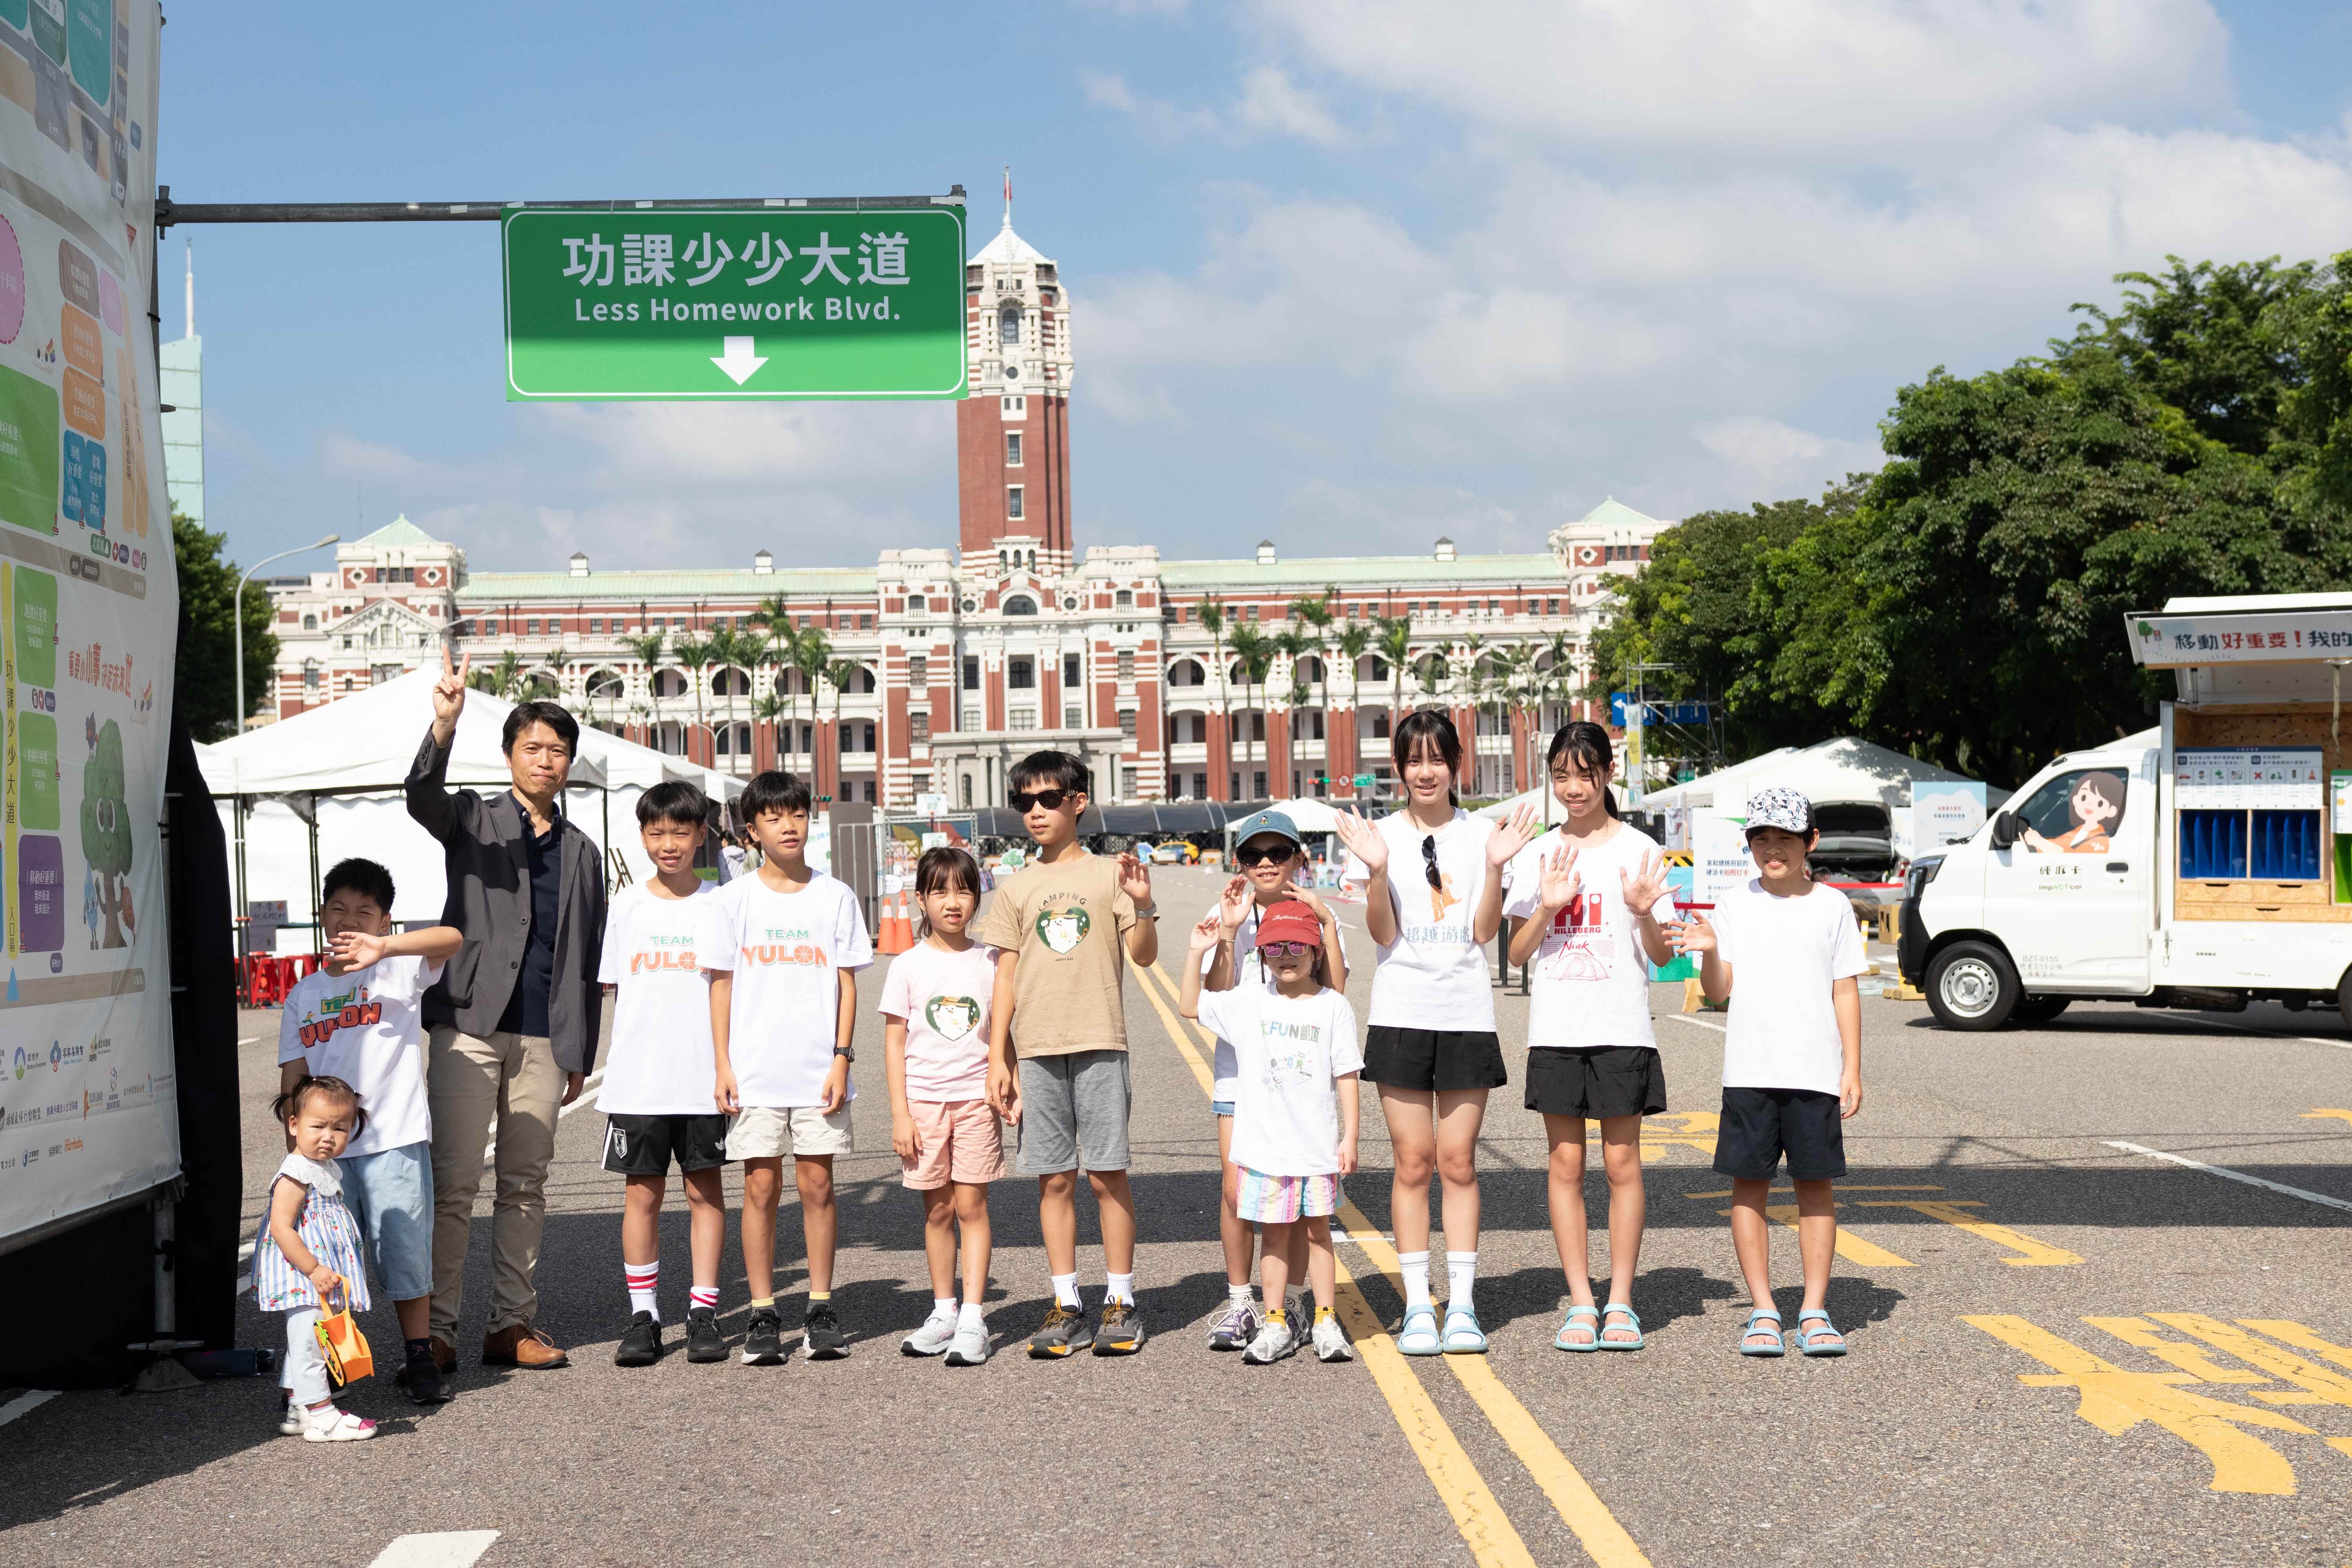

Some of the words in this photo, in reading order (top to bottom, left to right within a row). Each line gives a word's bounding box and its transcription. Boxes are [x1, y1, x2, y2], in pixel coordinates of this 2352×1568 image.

[563, 232, 910, 286] 功課少少大道
[576, 299, 639, 321] Less
[652, 297, 813, 320] Homework
[826, 296, 899, 320] Blvd.
[6, 660, 16, 824] 功課少少大道
[30, 870, 54, 885] 移動好重要
[34, 890, 50, 901] 我的街道
[1038, 892, 1087, 912] CAMPING
[34, 903, 50, 915] 我來設計
[766, 928, 810, 940] TEAM
[1405, 926, 1470, 944] 超越遊戲
[1554, 927, 1601, 935] HILLEBERG
[650, 935, 694, 946] TEAM
[630, 950, 707, 975] YULO
[742, 944, 828, 969] YULON
[299, 1002, 382, 1049] YUON
[63, 1045, 84, 1058] 客家委員會
